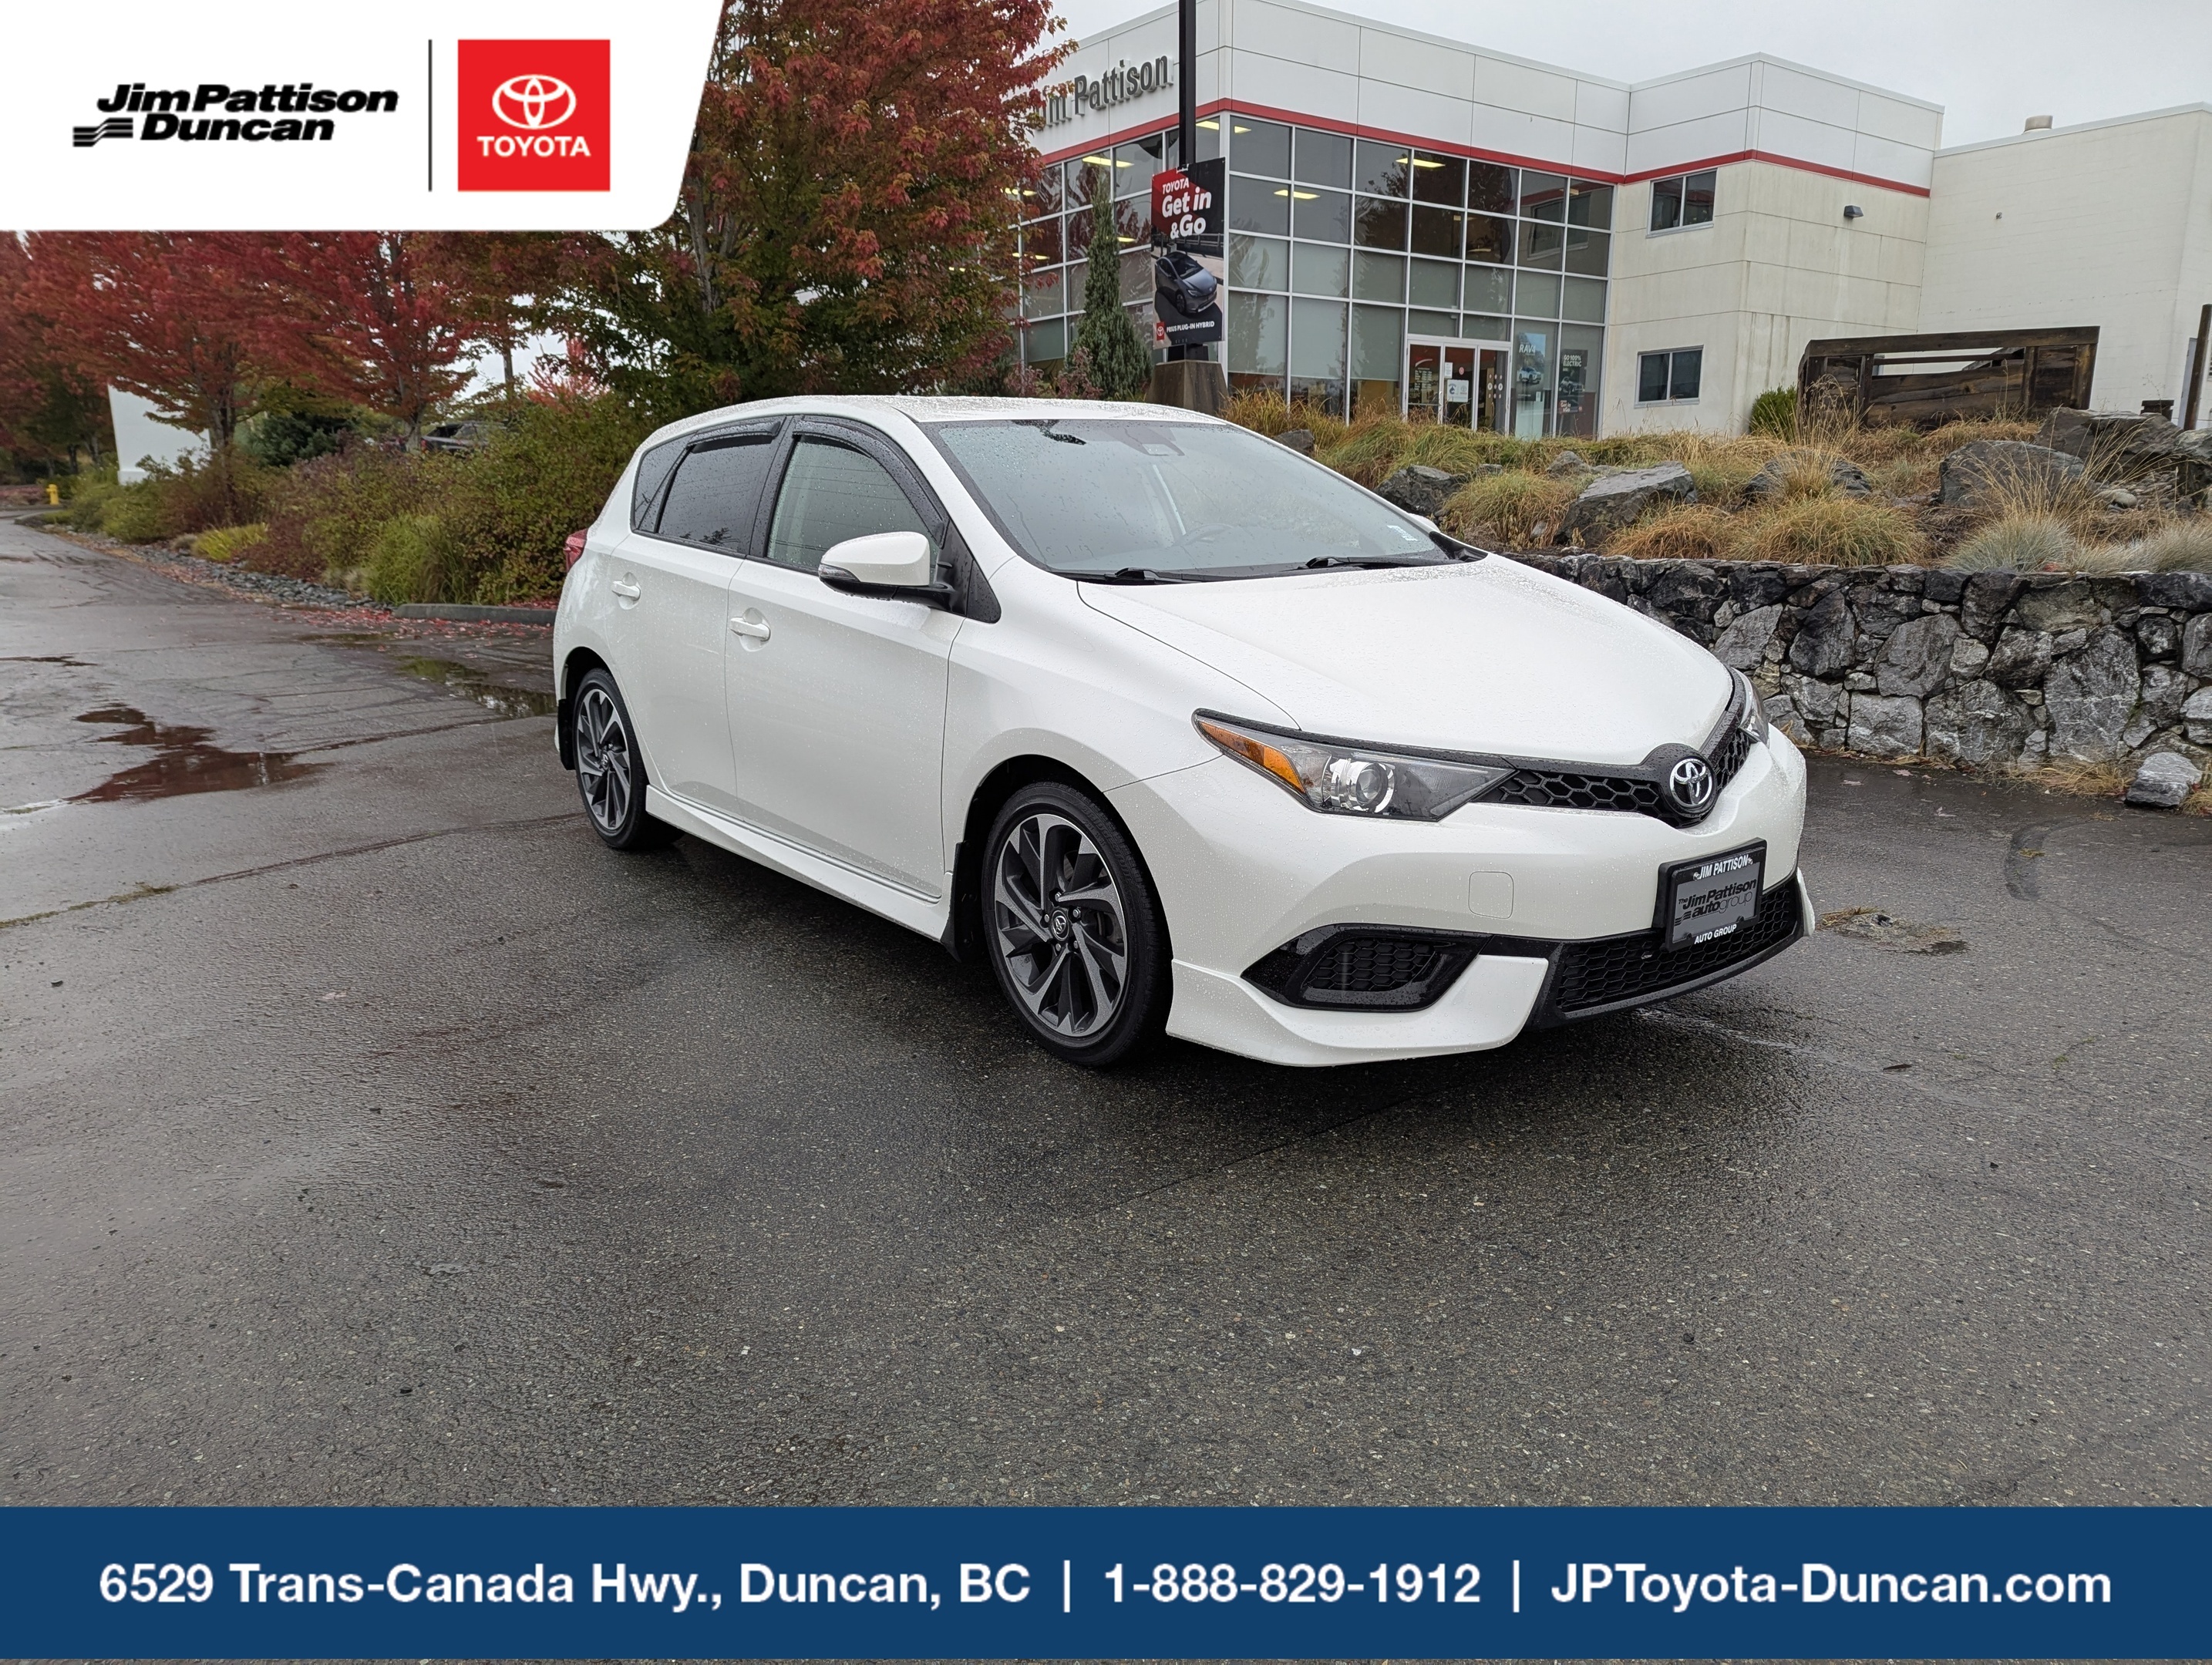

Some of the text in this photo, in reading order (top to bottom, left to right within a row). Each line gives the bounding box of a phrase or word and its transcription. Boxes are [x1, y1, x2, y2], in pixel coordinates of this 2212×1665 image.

[1075, 55, 1170, 116] Pattison
[1162, 177, 1190, 195] TOYOTA
[1162, 186, 1212, 218] Get in
[1177, 323, 1195, 331] PLUG-IN
[1195, 321, 1215, 329] HYBRID
[1519, 344, 1536, 353] RAV4
[1698, 854, 1749, 880] JIM PATTISON
[1682, 894, 1706, 910] Jim
[1705, 879, 1757, 903] Pattison
[1694, 923, 1737, 945] AUTO GROUP
